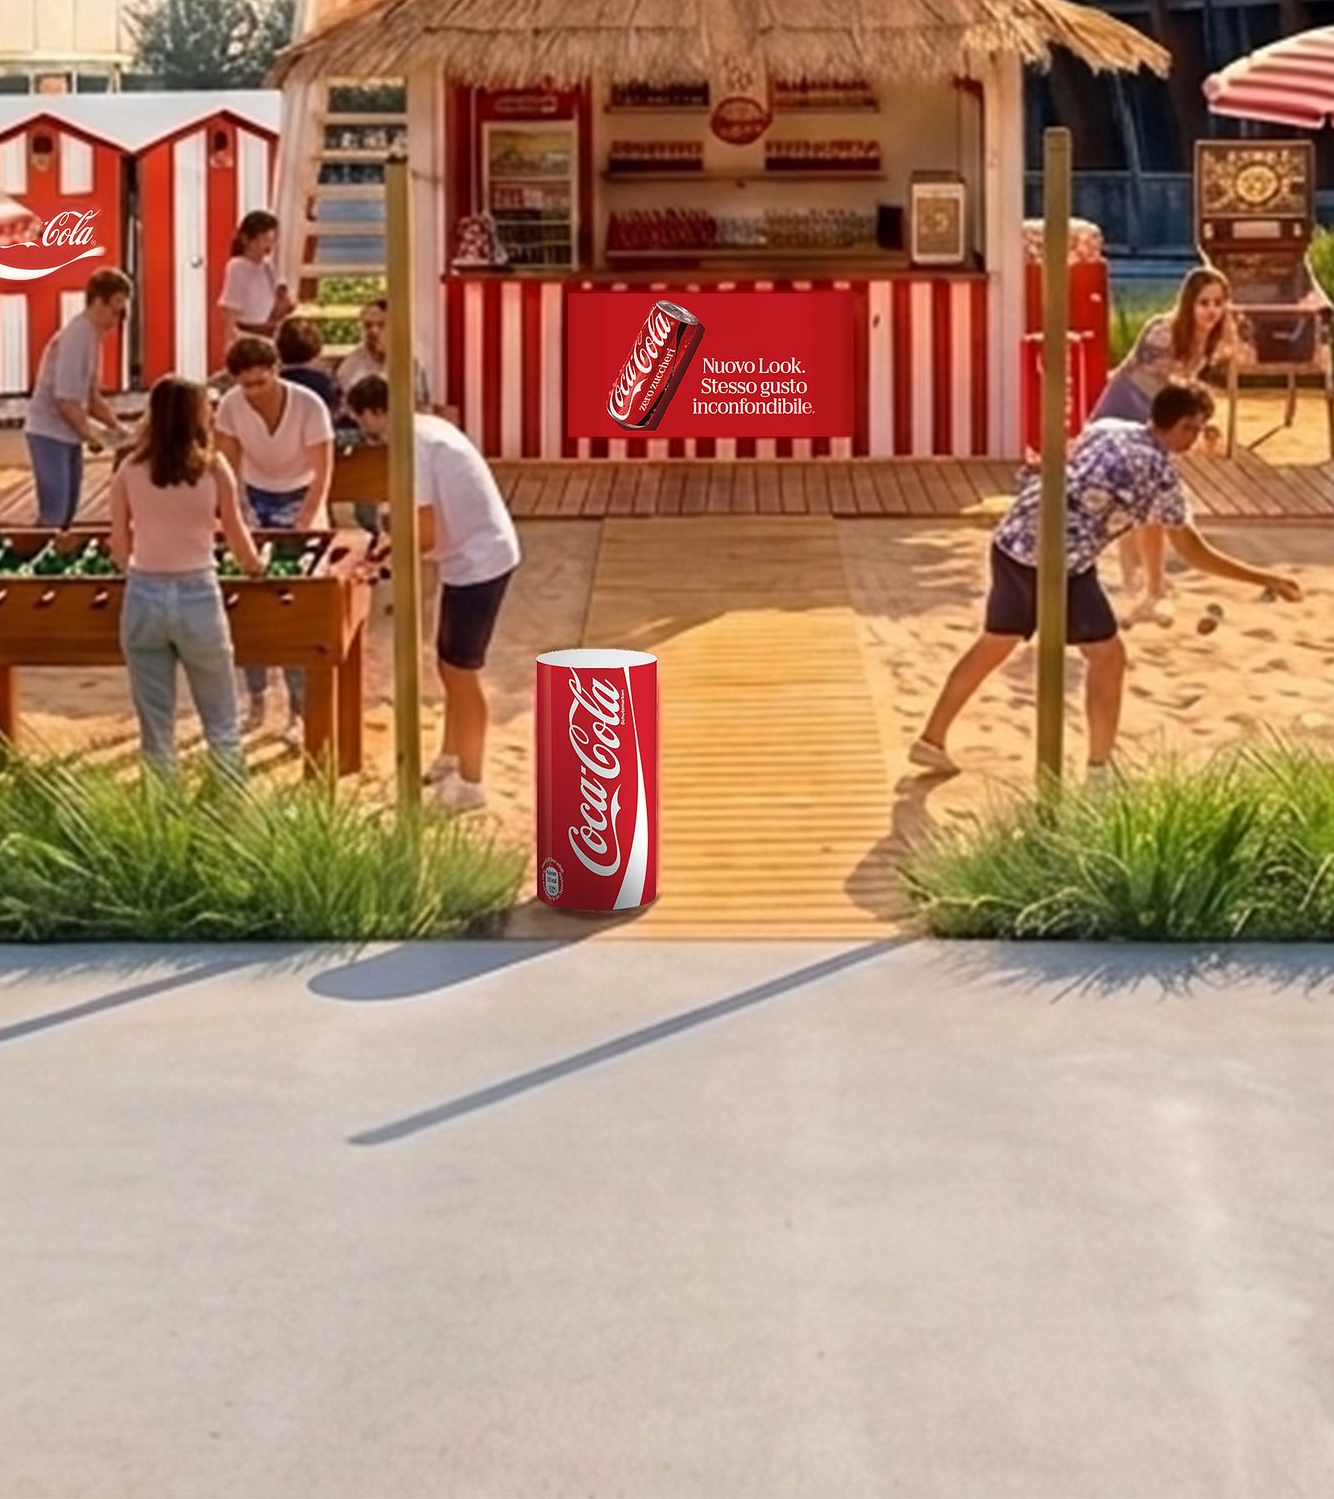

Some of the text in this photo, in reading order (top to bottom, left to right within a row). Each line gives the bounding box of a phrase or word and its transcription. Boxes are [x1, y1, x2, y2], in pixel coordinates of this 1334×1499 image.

[702, 357, 806, 374] Nuovo Look.
[639, 348, 676, 412] zero zuccheri
[700, 377, 808, 397] Stesso gusto
[692, 398, 816, 415] inconfondibile.
[568, 666, 622, 877] Coca-Cola
